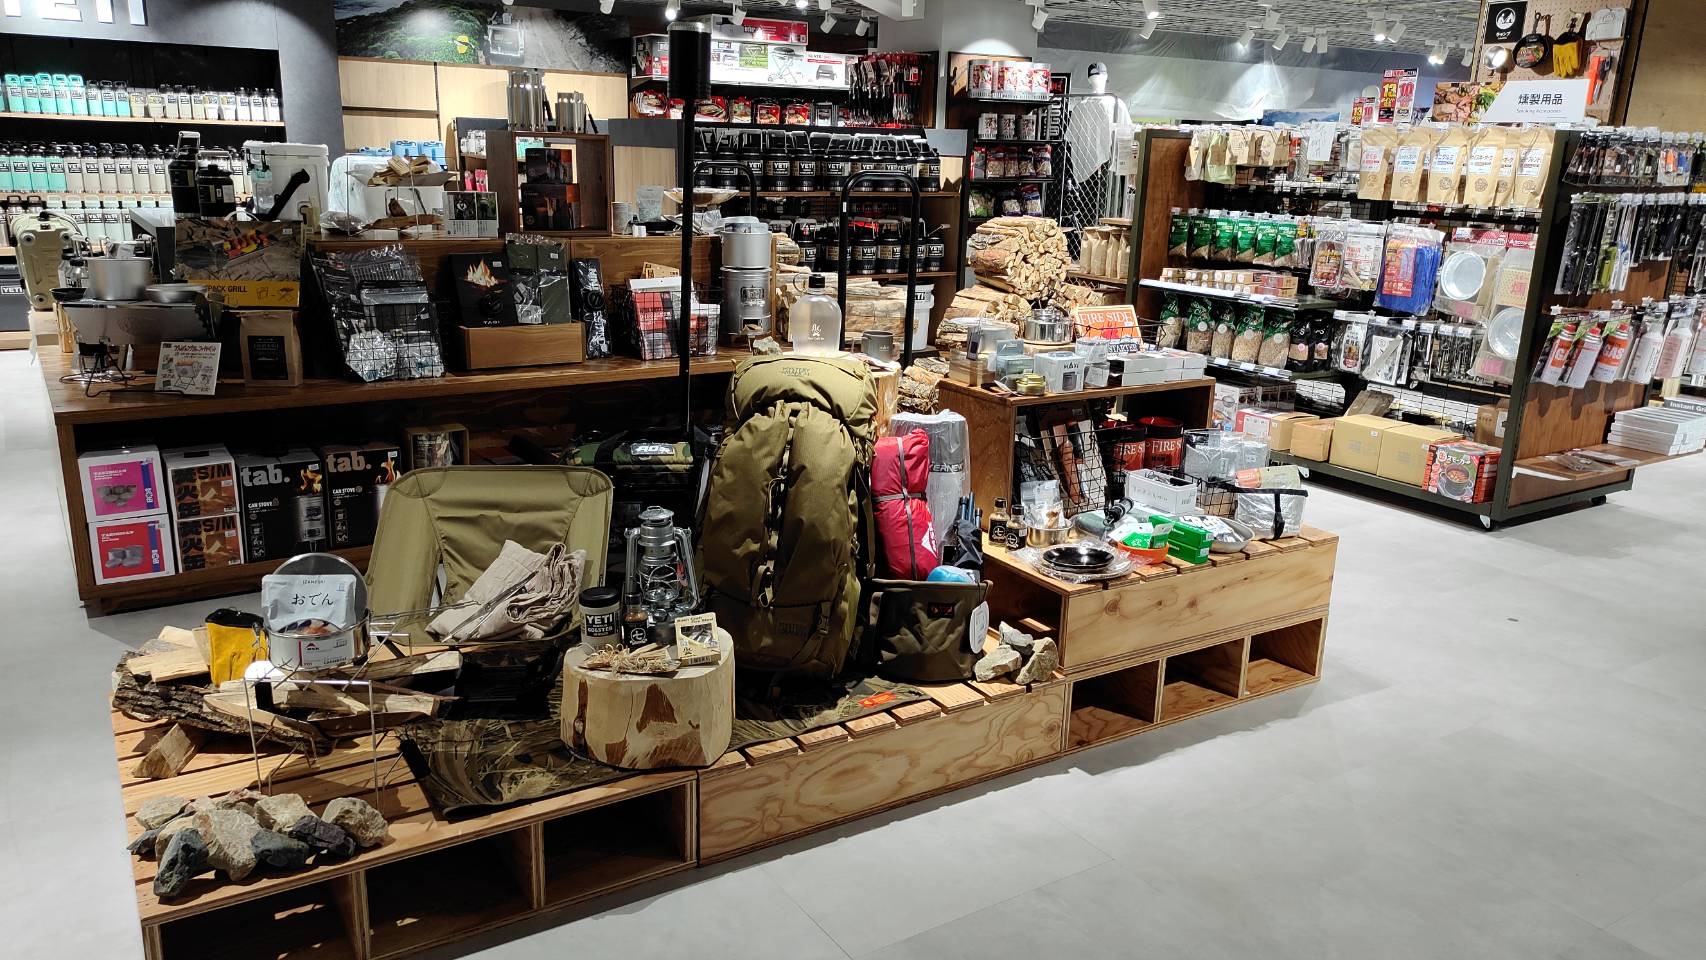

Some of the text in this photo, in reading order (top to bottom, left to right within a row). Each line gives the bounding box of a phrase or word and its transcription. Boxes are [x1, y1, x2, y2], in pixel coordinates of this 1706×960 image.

[1382, 83, 1398, 98] 13
[1517, 93, 1564, 106] 燻製用品
[227, 285, 248, 293] GRILL
[1079, 311, 1133, 325] FIRE SIDE
[1603, 345, 1625, 359] GAS
[1670, 401, 1695, 411] Instant
[1152, 440, 1175, 454] FIRE
[326, 451, 372, 474] tab.
[198, 462, 232, 481] SIM
[241, 464, 290, 487] tab.
[202, 515, 237, 533] SIM
[290, 593, 334, 606] おでん
[586, 614, 614, 625] YETI
